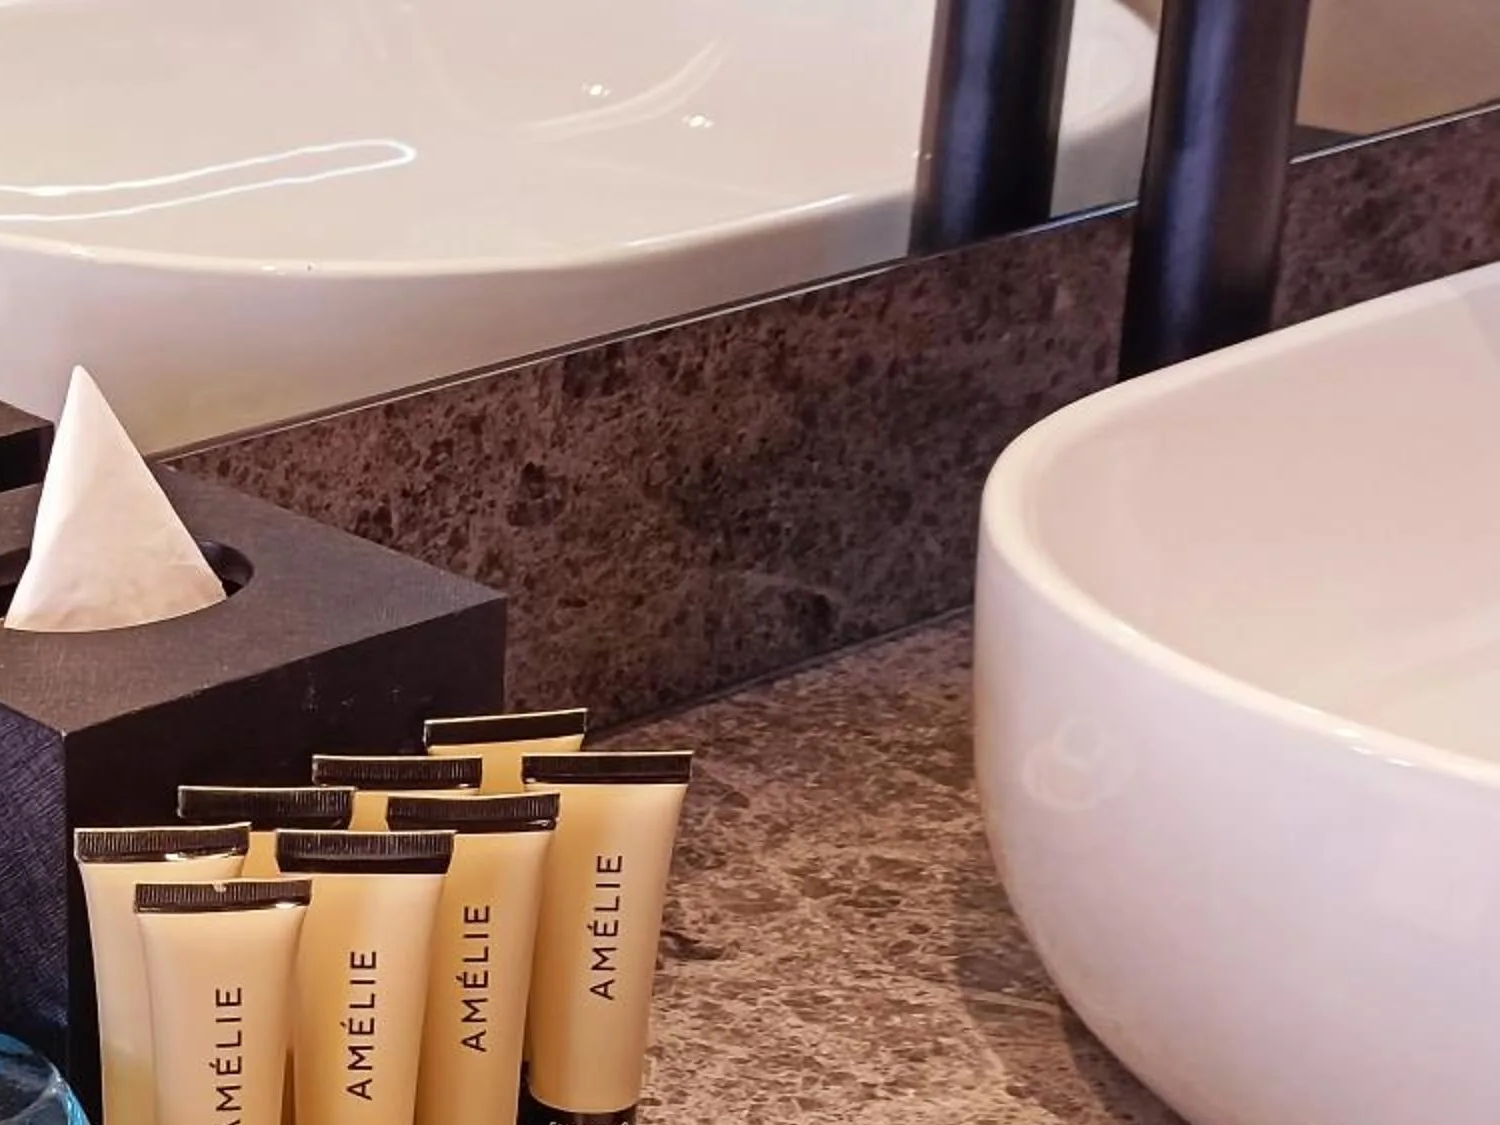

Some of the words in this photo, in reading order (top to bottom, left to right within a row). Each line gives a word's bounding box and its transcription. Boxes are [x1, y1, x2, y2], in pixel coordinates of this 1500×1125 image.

[456, 904, 491, 1053] AMÉLIE
[587, 853, 623, 1001] AMÉLIE
[340, 949, 377, 1100] AMÉLIE
